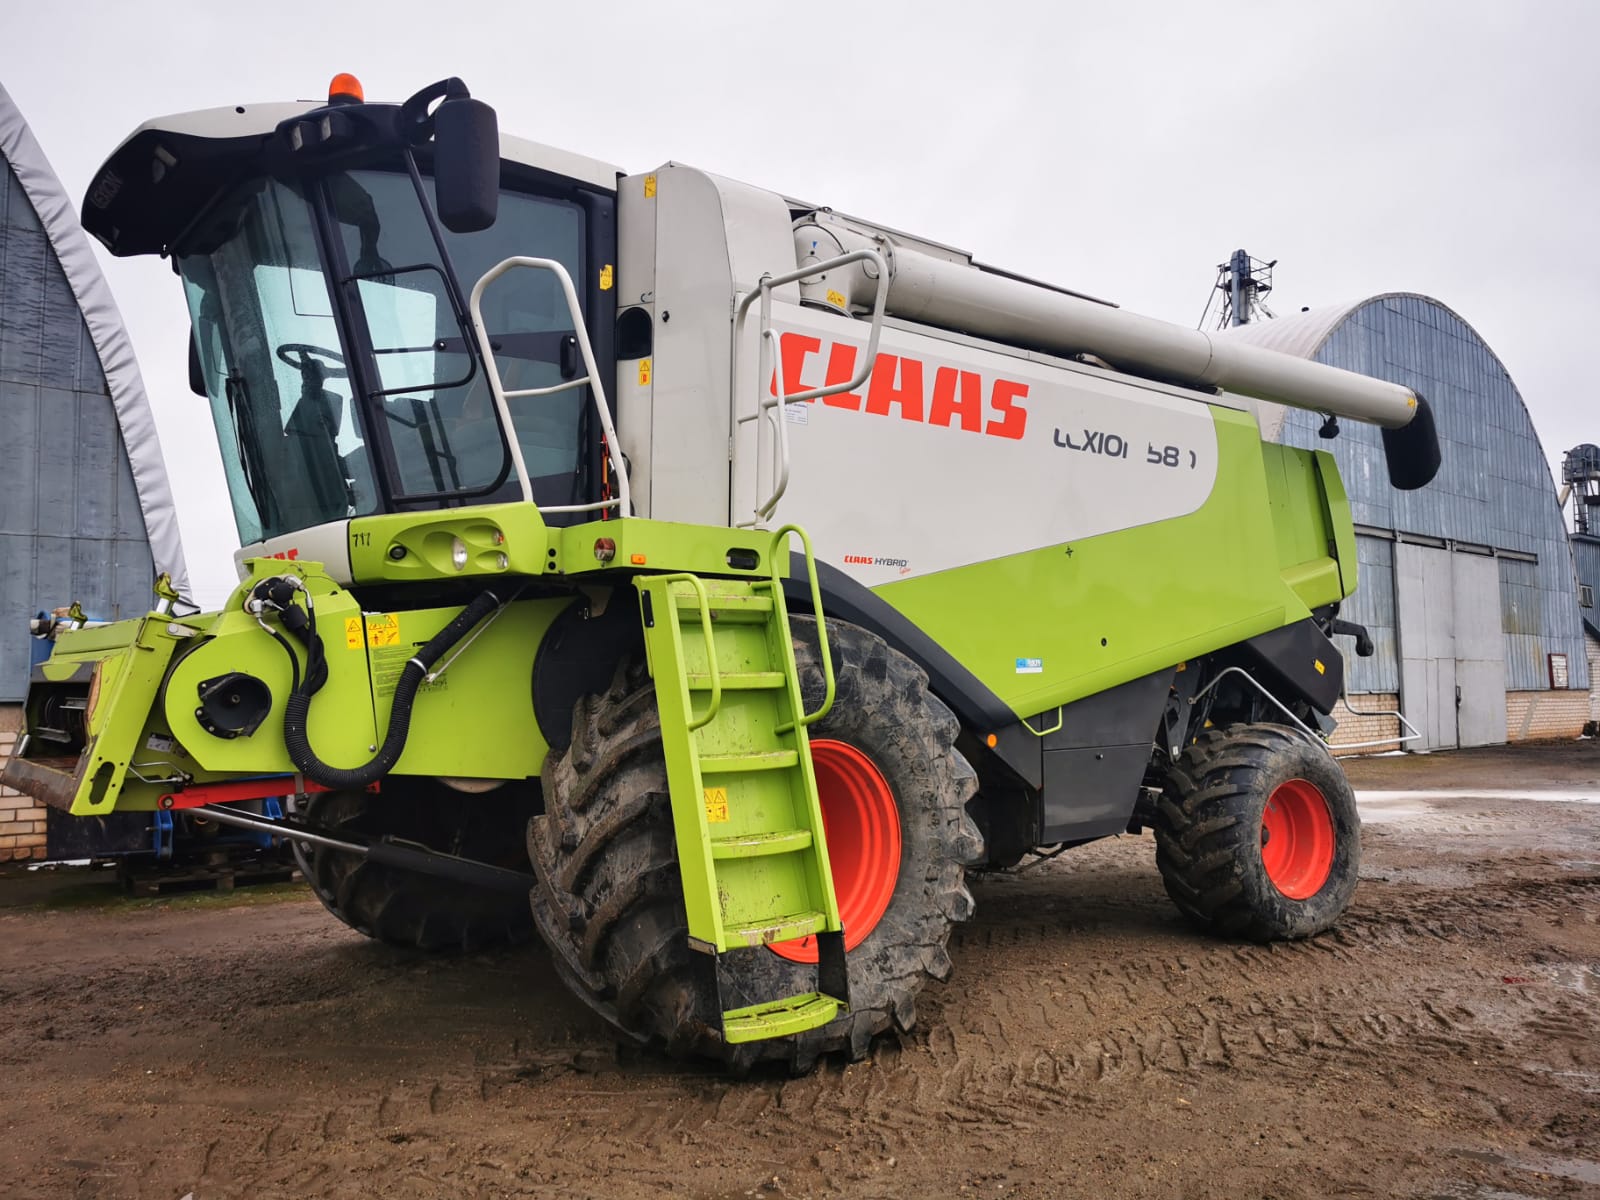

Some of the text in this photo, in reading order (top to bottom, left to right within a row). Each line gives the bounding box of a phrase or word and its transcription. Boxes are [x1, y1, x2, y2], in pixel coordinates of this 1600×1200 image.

[770, 332, 1029, 440] CLAAS
[844, 555, 908, 567] CLAAS HYBRID
